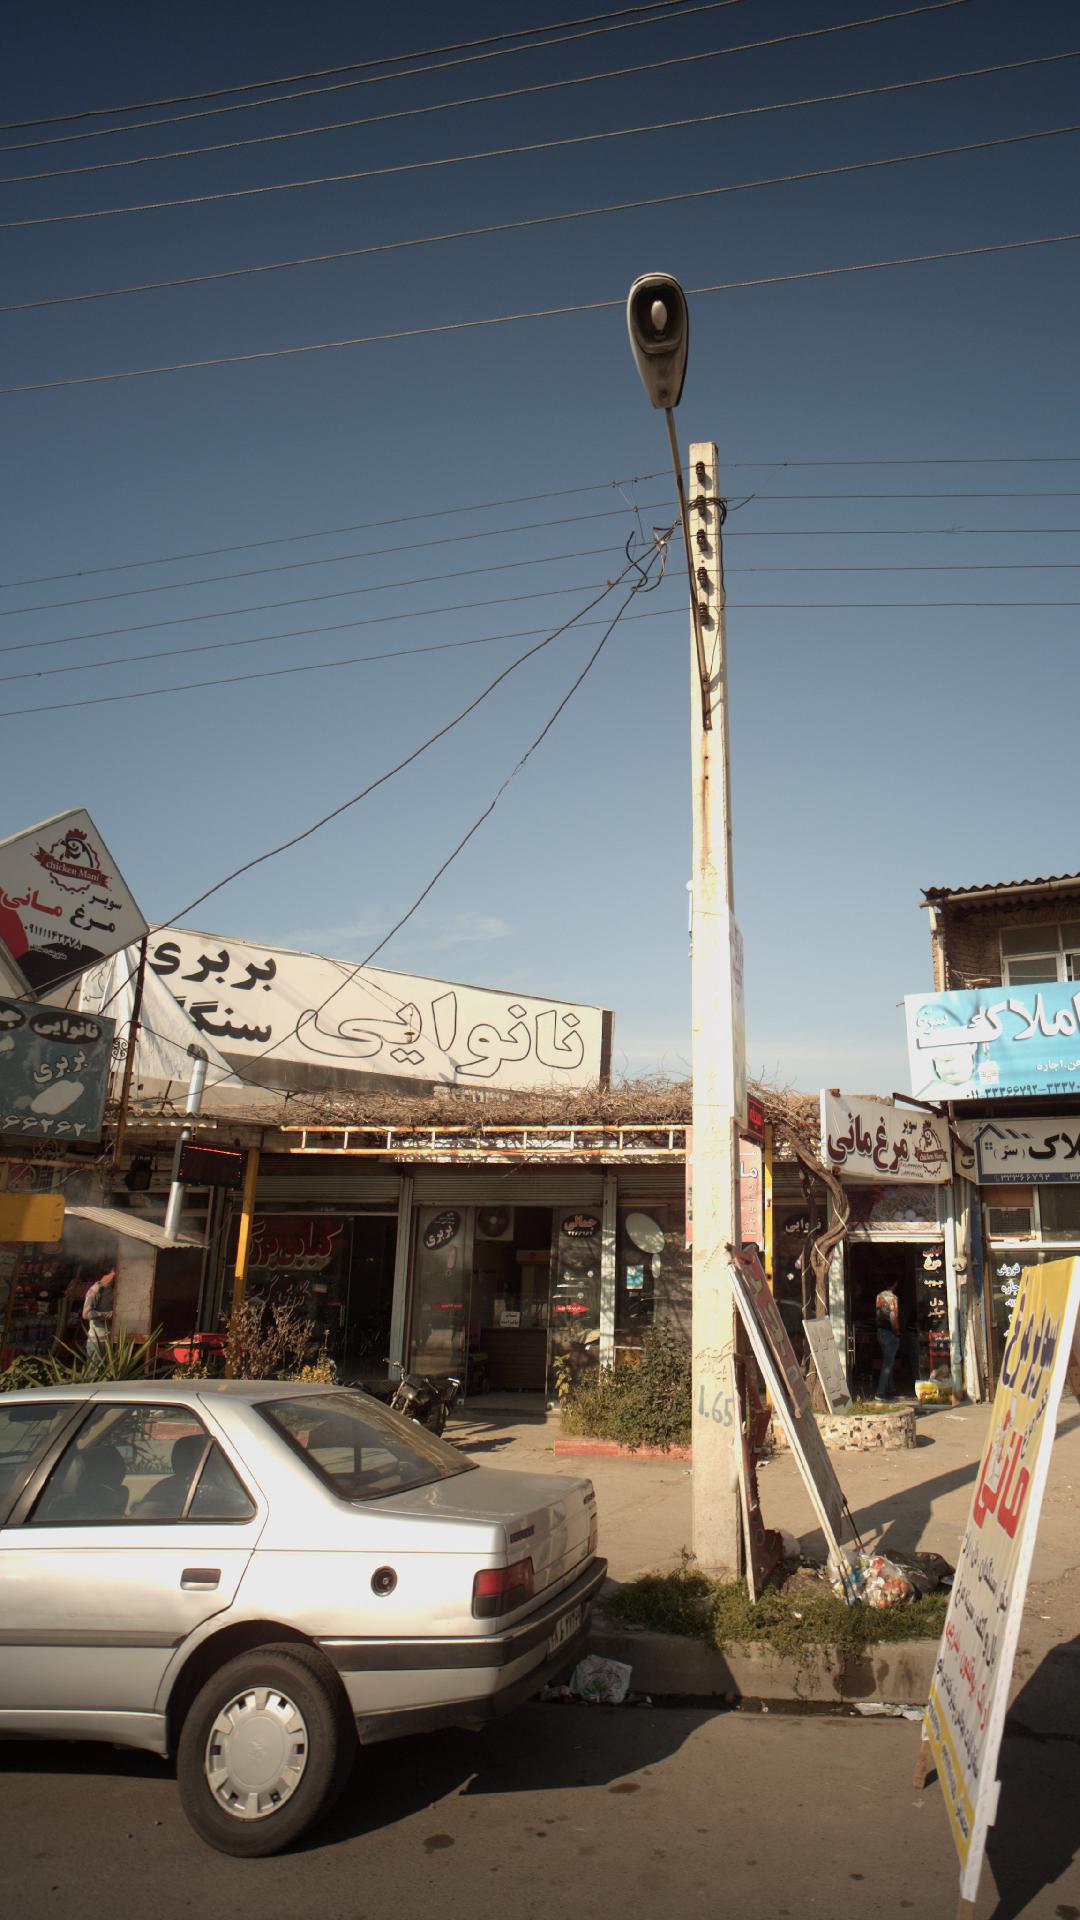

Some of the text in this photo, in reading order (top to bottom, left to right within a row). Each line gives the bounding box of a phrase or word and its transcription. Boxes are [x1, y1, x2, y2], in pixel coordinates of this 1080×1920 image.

[2, 887, 115, 933] مرغ مانی
[150, 942, 277, 990] بربری
[33, 1018, 99, 1039] نانوایی
[173, 996, 272, 1043] سنگ
[296, 991, 584, 1078] نانوایی
[33, 1049, 88, 1084] بربری
[827, 1112, 874, 1164] مانی
[873, 1116, 909, 1173] مرغ
[1003, 1273, 1061, 1400] سوپر مرغ
[698, 1384, 733, 1427] 1.65
[974, 1431, 1030, 1538] مانی
